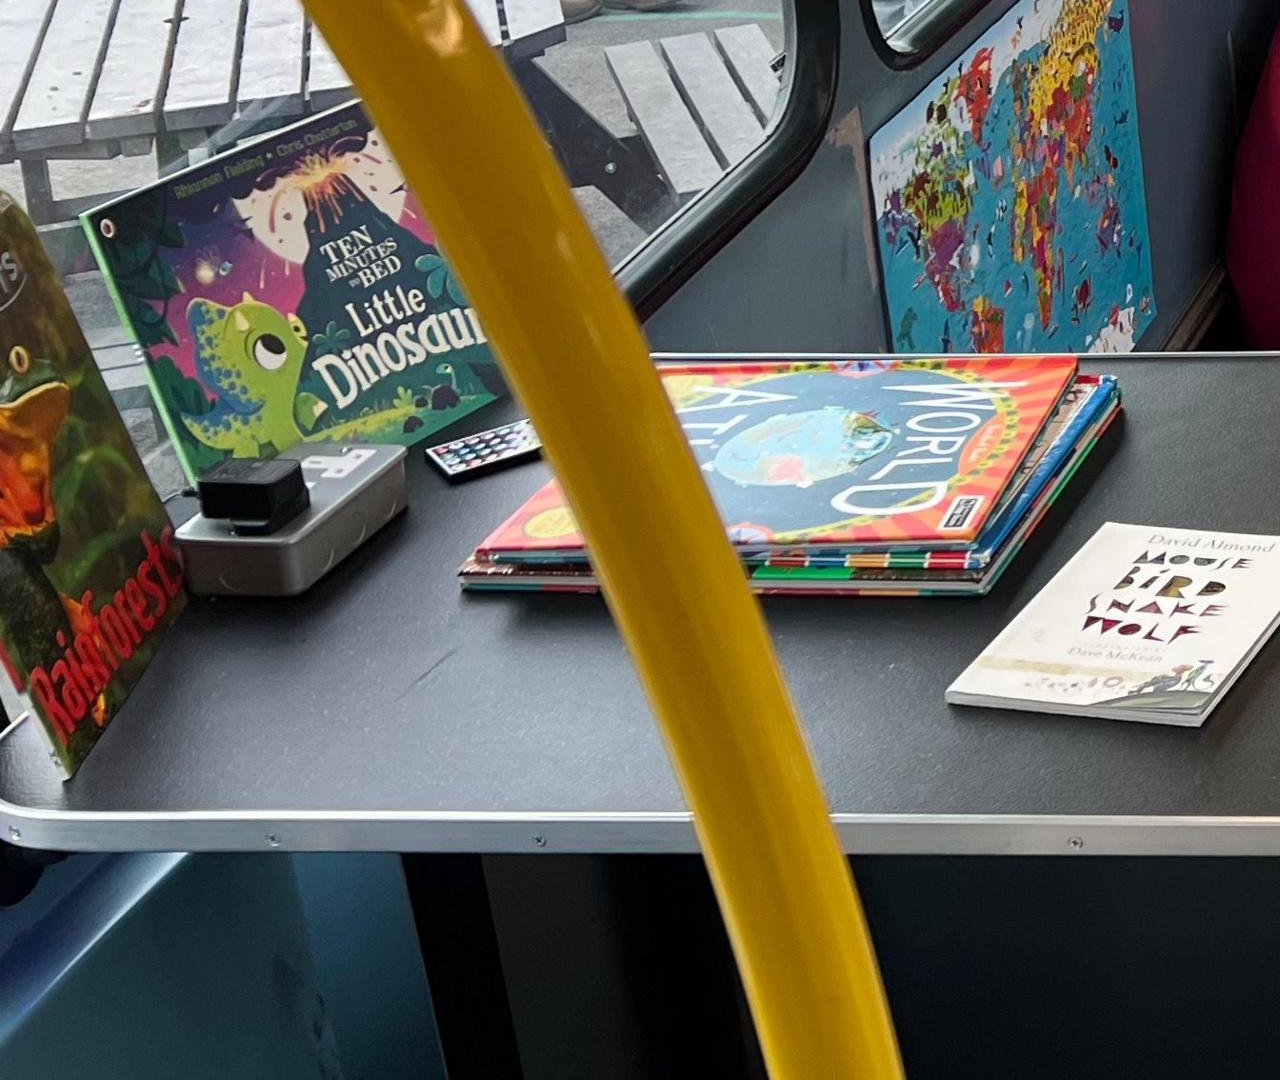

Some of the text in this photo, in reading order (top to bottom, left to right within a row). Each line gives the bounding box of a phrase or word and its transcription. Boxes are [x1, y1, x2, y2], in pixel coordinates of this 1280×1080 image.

[319, 224, 374, 265] TEN
[325, 236, 398, 282] MINUTES
[358, 254, 402, 288] BED
[345, 284, 427, 338] Little
[311, 306, 488, 410] Dinosaur
[831, 381, 1030, 516] WORLD
[1132, 550, 1254, 570] MOUSE
[1148, 533, 1276, 554] David Almond
[1086, 593, 1230, 618] SNAKE
[30, 524, 185, 745] Rainforests
[1082, 615, 1204, 645] WOLF
[1105, 649, 1163, 663] McKean
